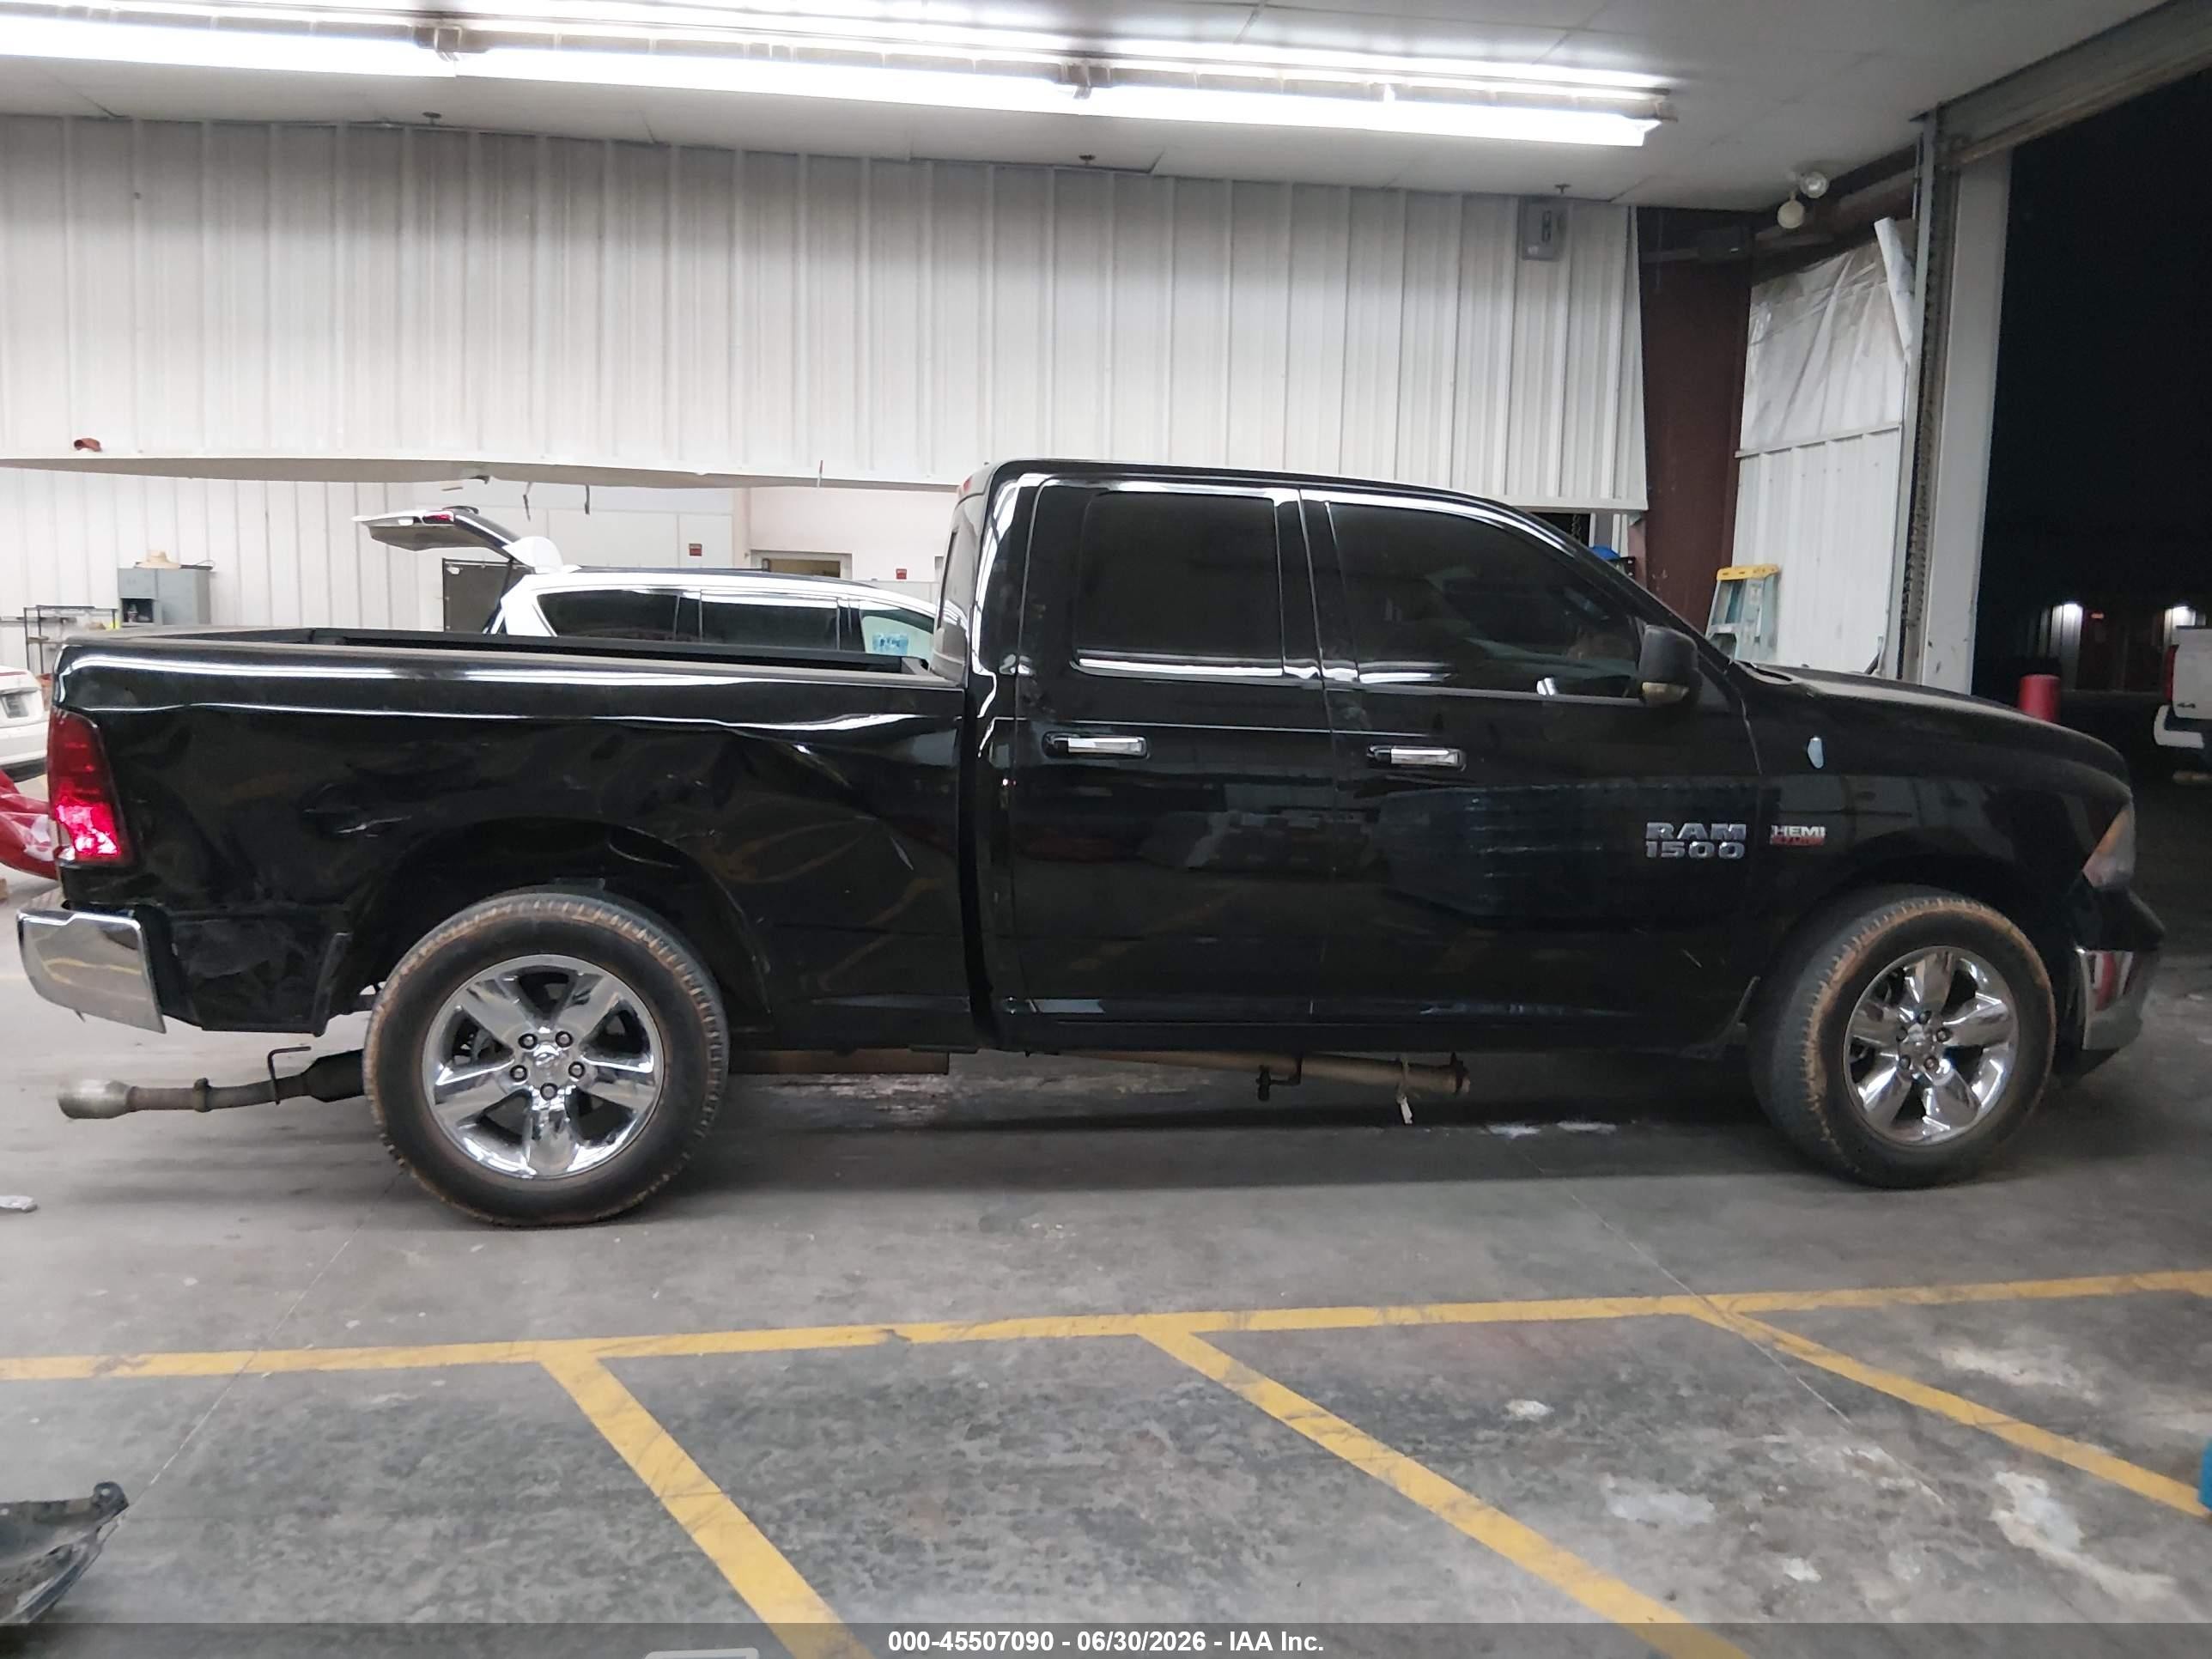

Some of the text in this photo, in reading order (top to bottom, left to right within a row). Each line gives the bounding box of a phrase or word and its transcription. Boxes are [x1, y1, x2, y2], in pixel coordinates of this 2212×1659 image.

[1646, 822, 1747, 840] RAM
[1771, 824, 1826, 838] HEMI
[1645, 841, 1746, 859] 1500
